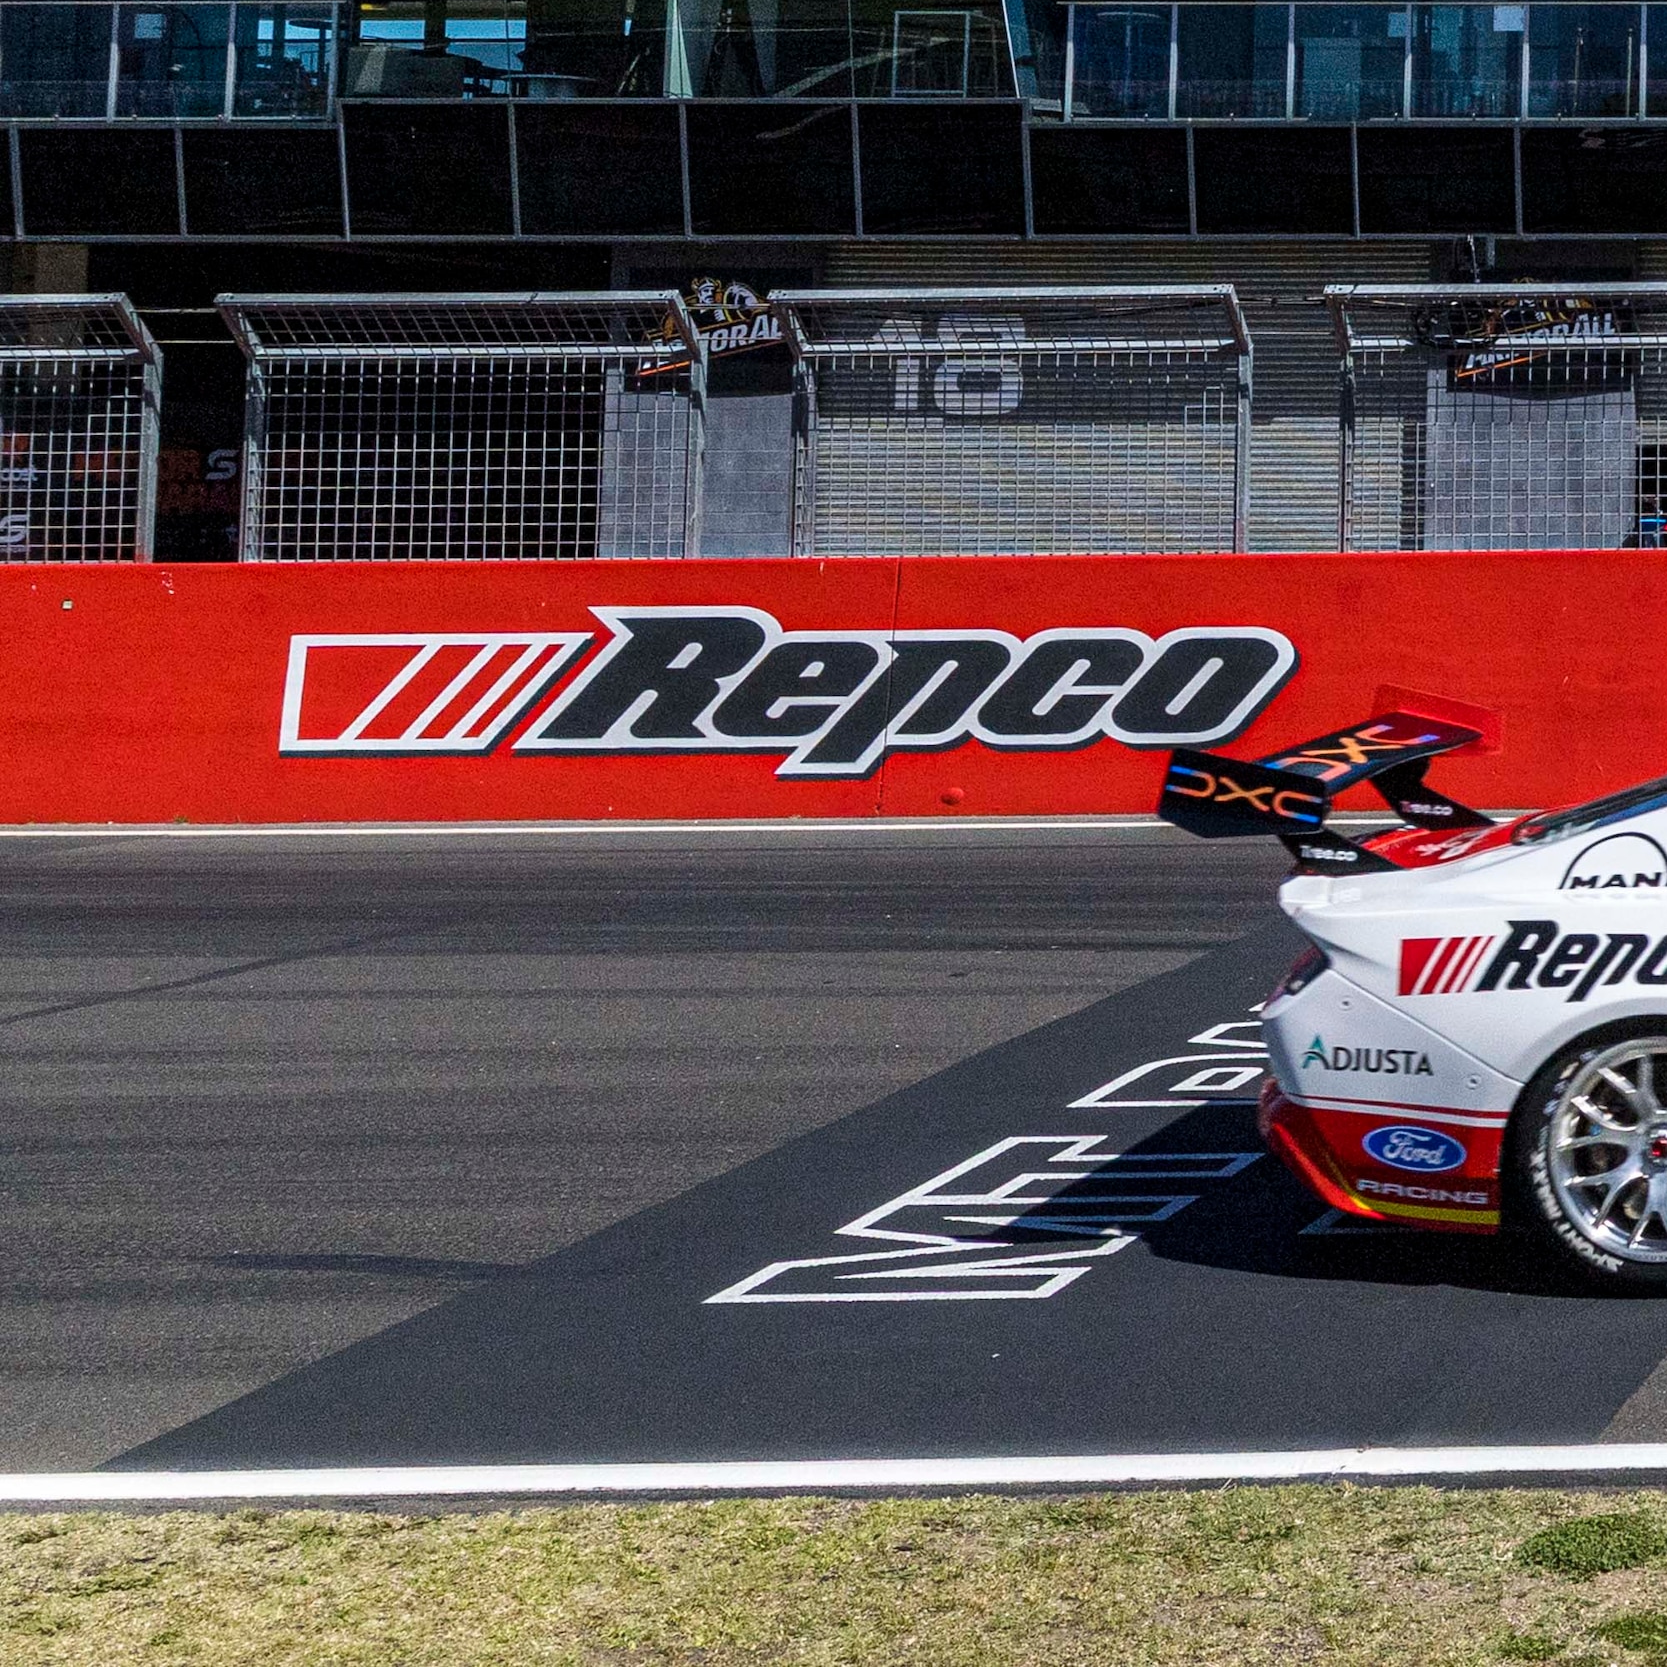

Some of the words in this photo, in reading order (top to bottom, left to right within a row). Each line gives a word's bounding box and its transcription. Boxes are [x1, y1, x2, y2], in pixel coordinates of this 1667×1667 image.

[512, 606, 1300, 779] Repco
[1570, 871, 1664, 890] MAN
[1301, 1035, 1434, 1077] ADJUSTA
[1382, 1130, 1447, 1167] Ford
[1356, 1179, 1489, 1205] RACING
